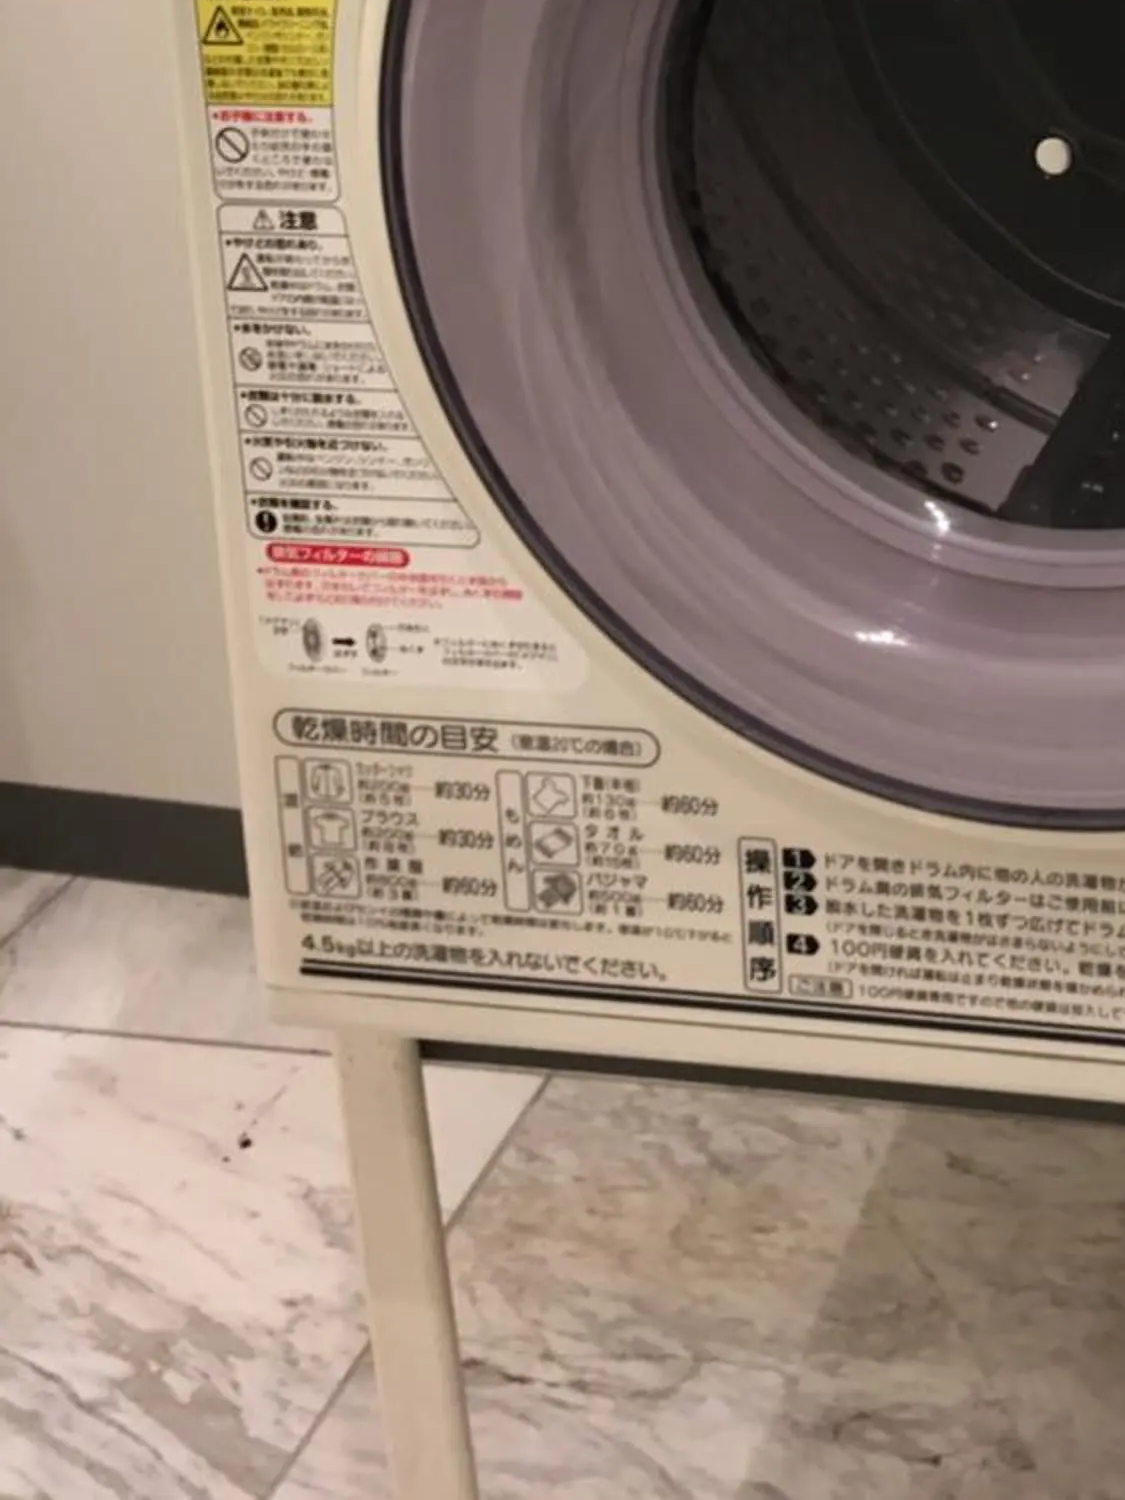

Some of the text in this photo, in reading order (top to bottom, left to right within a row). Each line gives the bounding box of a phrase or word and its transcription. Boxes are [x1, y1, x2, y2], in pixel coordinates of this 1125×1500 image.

[278, 209, 319, 231] 注意
[292, 715, 499, 754] 乾燥時間の目安
